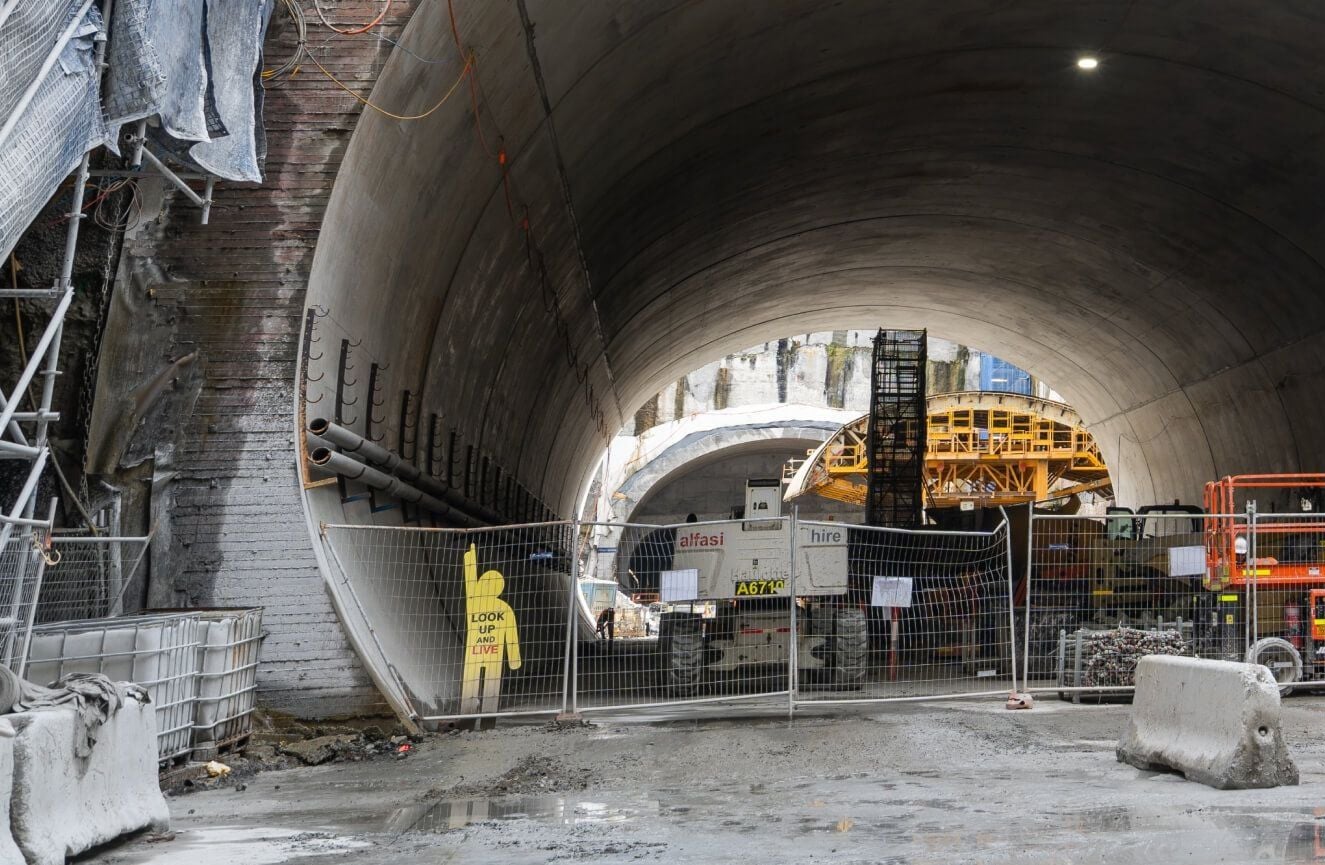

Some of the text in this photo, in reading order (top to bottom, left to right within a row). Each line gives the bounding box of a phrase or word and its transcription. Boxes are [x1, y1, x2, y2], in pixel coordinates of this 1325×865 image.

[680, 529, 841, 547] alfasi hire
[471, 613, 504, 622] LOOK
[480, 625, 495, 634] UP
[472, 646, 498, 654] LIVE
